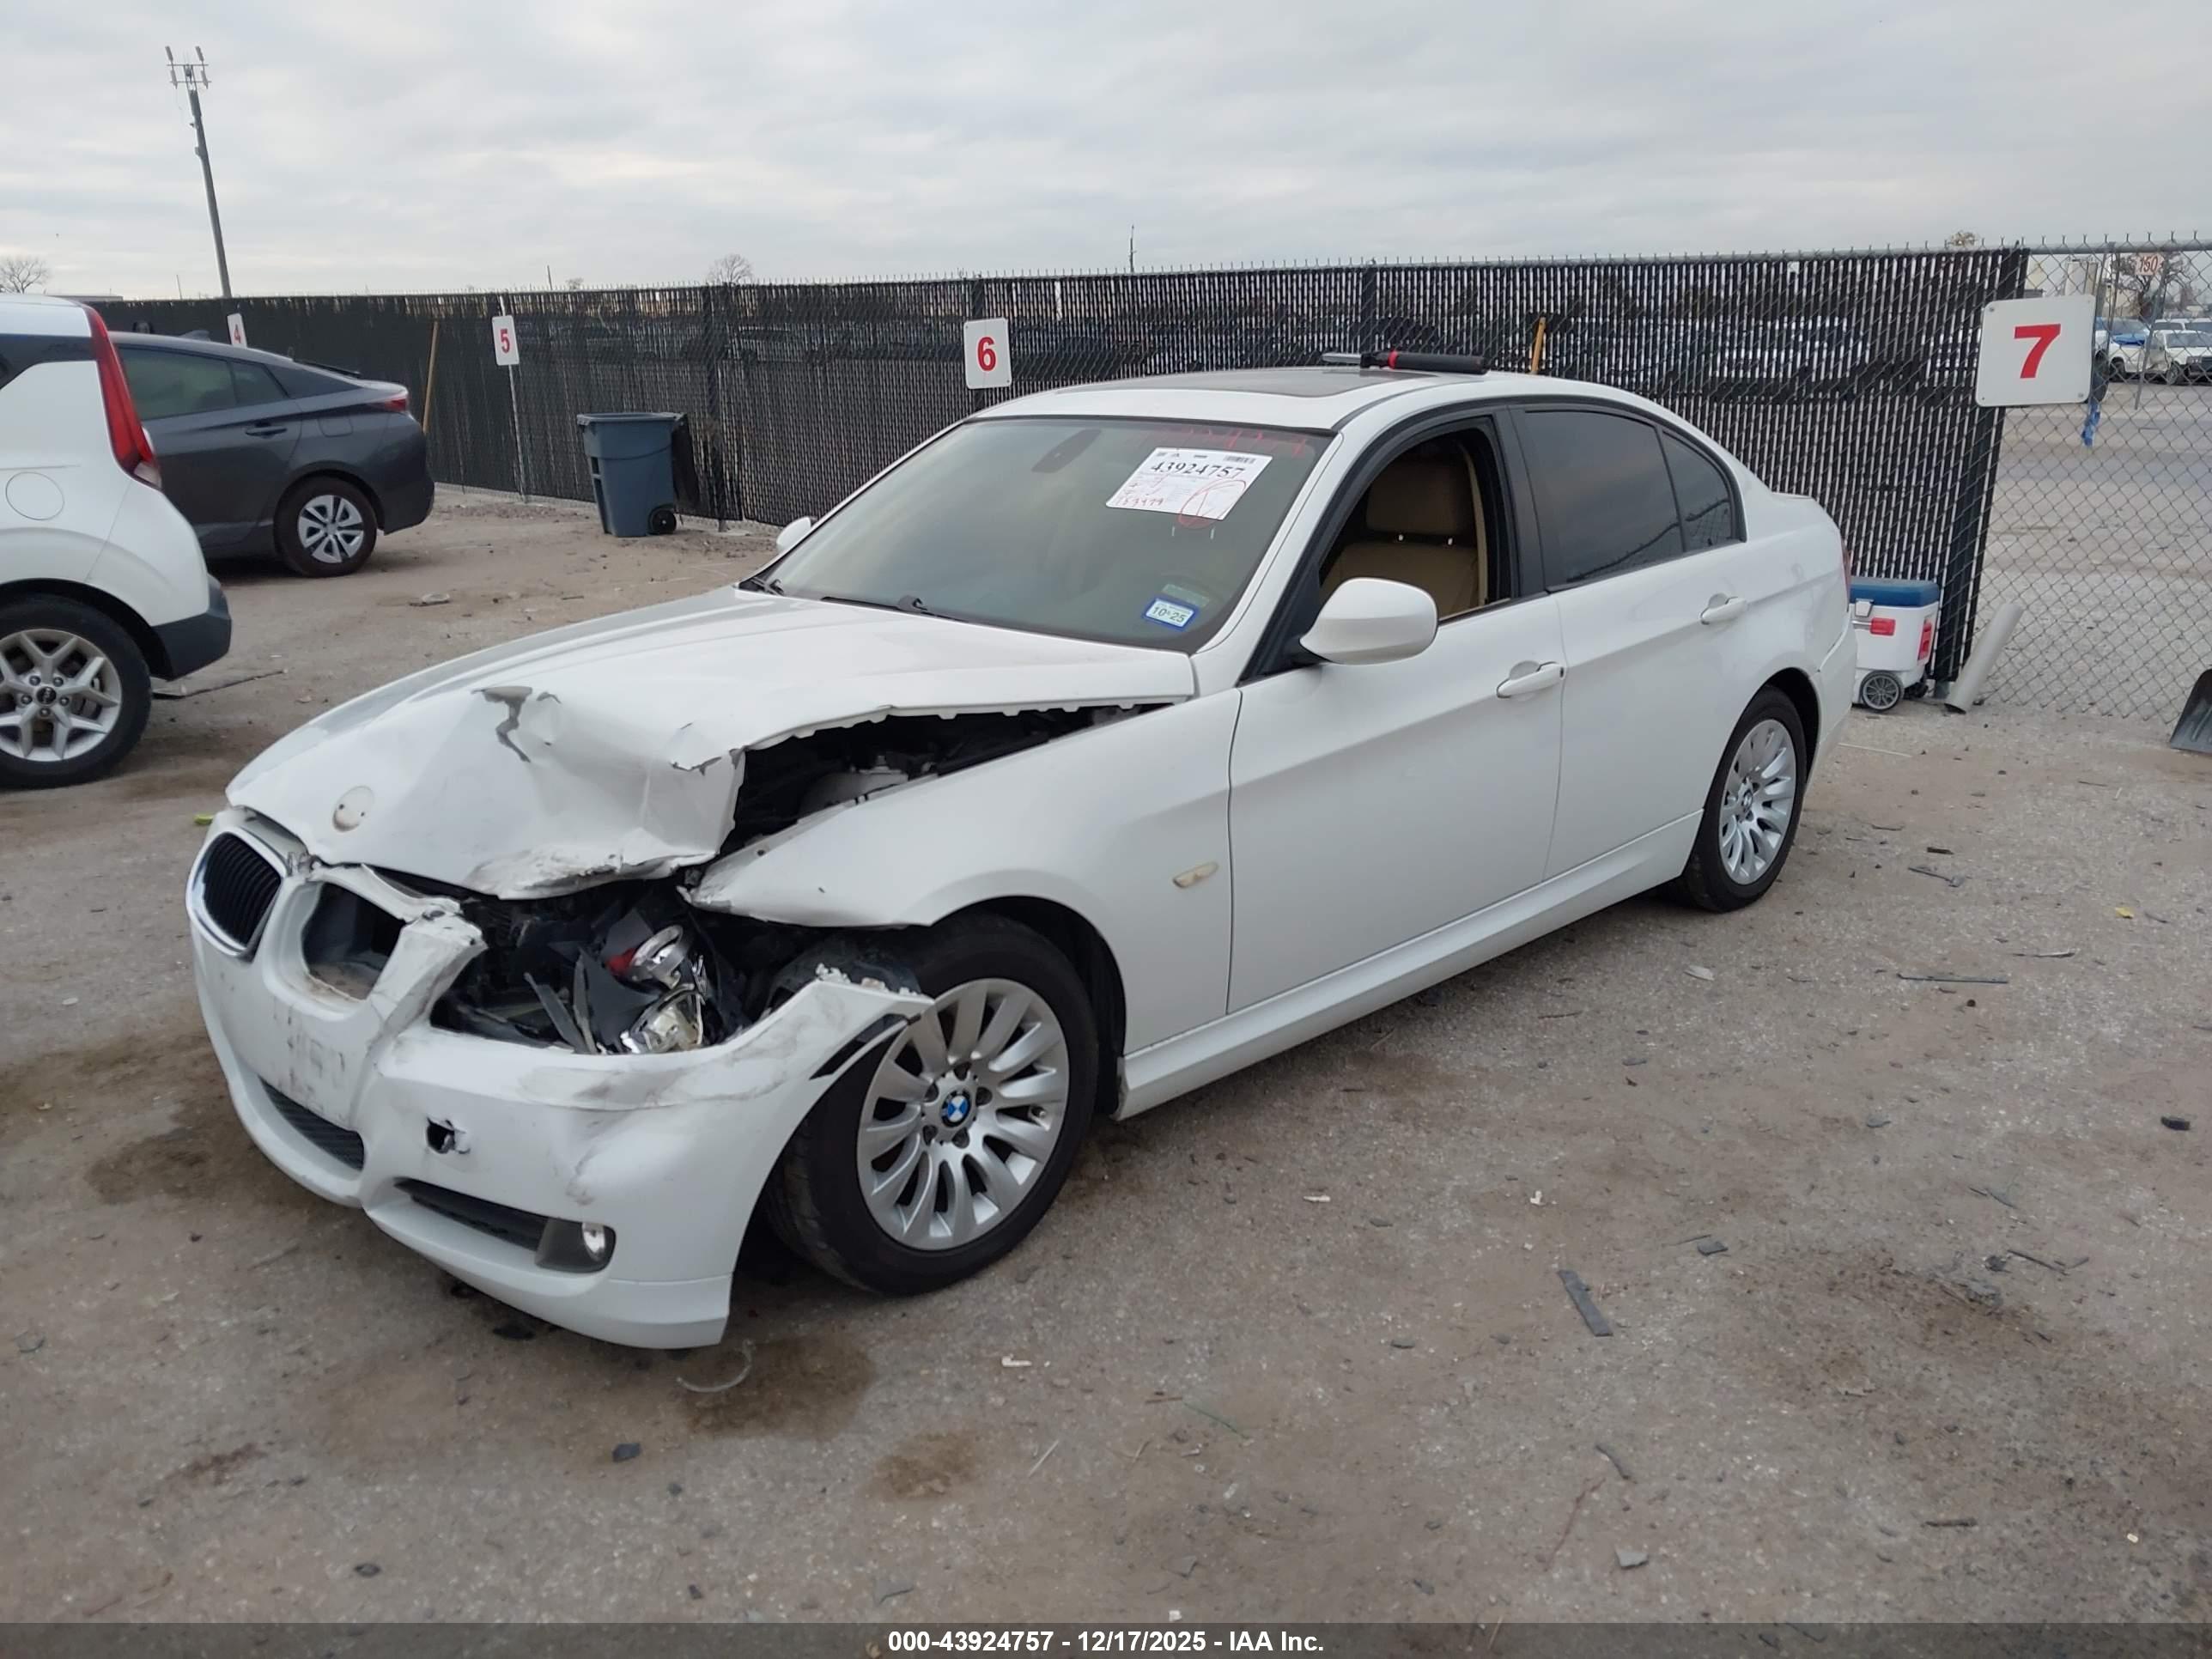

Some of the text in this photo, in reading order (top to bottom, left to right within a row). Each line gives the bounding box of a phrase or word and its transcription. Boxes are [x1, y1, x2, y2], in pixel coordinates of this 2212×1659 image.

[234, 323, 241, 344] 4
[500, 328, 511, 354] 5
[977, 337, 996, 372] 6
[2014, 323, 2062, 379] 7
[1151, 460, 1245, 479] 43924757
